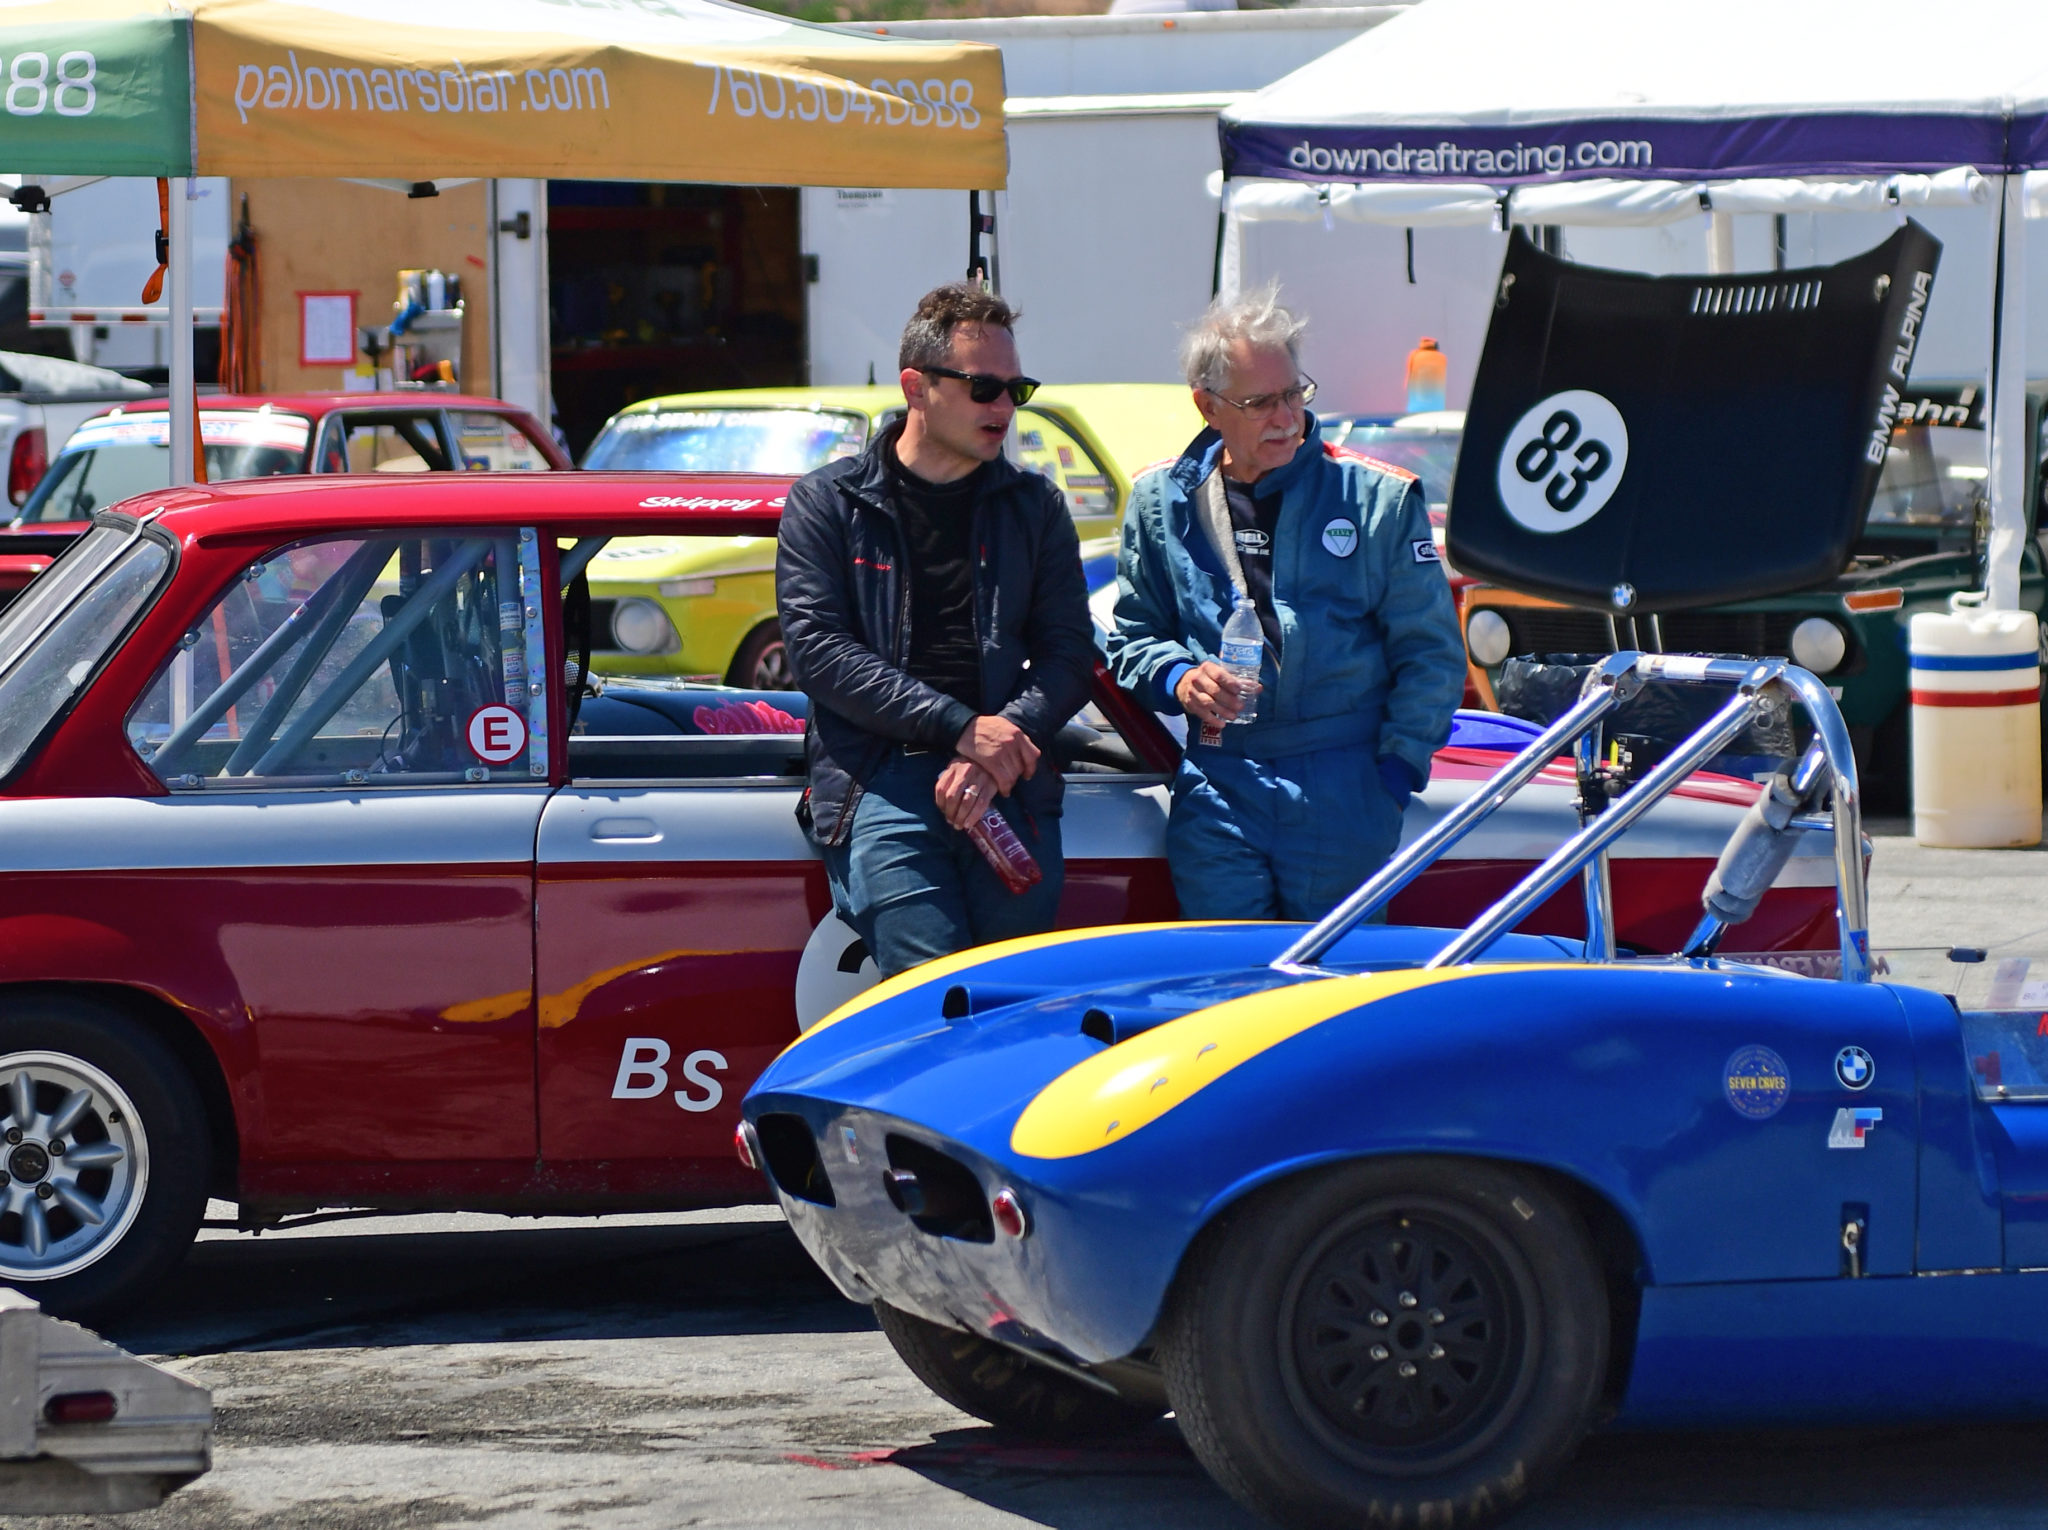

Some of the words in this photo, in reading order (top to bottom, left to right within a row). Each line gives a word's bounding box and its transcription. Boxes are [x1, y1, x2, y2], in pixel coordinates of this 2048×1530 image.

[0, 51, 97, 116] 88
[234, 50, 611, 125] palomarsolar.com
[1289, 141, 1653, 176] downdraftracing.com
[1867, 383, 1901, 465] BMW
[1891, 270, 1933, 380] ALPINA
[1515, 408, 1613, 513] 83
[638, 496, 764, 511] Skippy
[483, 716, 511, 751] E
[1729, 1076, 1757, 1089] SEVEN
[1758, 1076, 1786, 1089] CAVES
